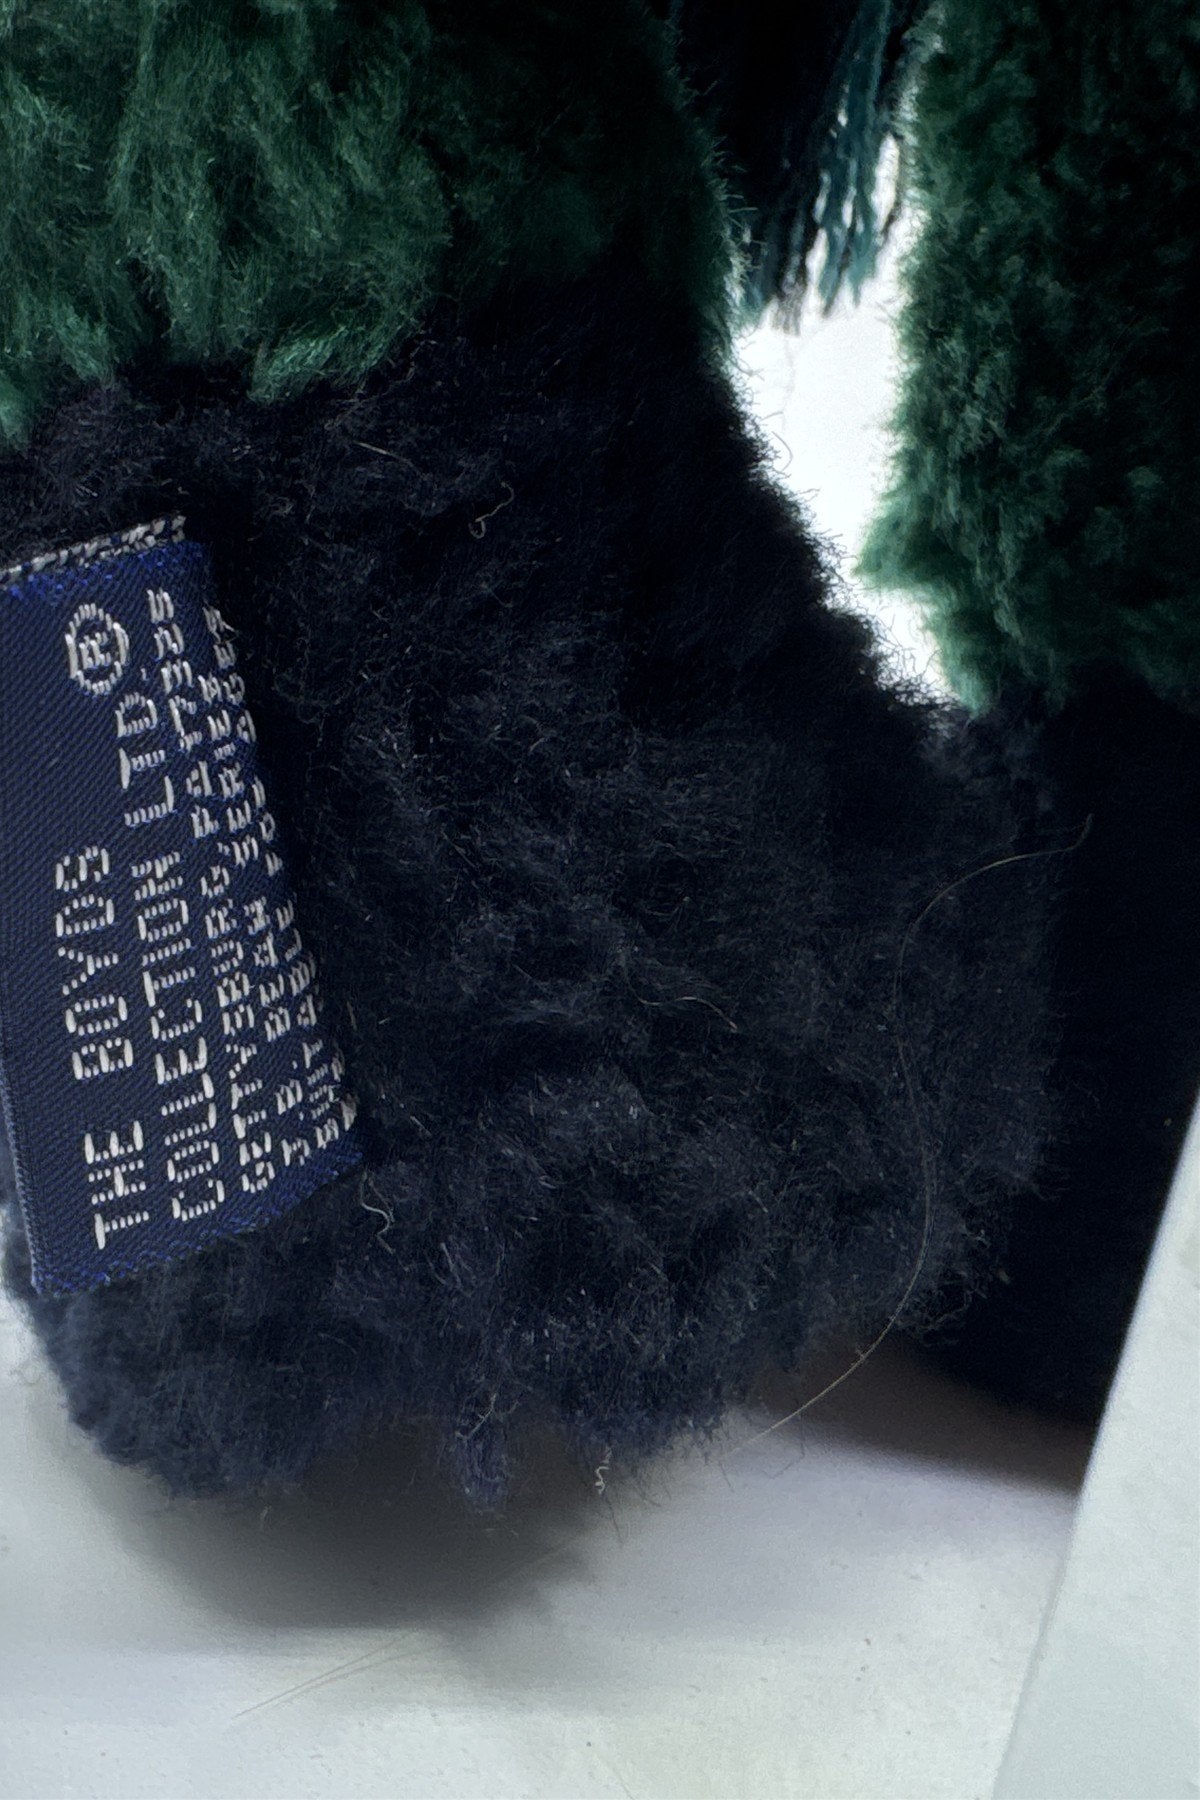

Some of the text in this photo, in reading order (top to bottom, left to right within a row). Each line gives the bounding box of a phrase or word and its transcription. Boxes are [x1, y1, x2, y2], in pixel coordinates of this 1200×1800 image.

[197, 672, 259, 868] SERIES
[54, 845, 150, 1250] THE BOYDS
[130, 851, 226, 1222] COLLECTION
[243, 896, 291, 1043] BEAN
